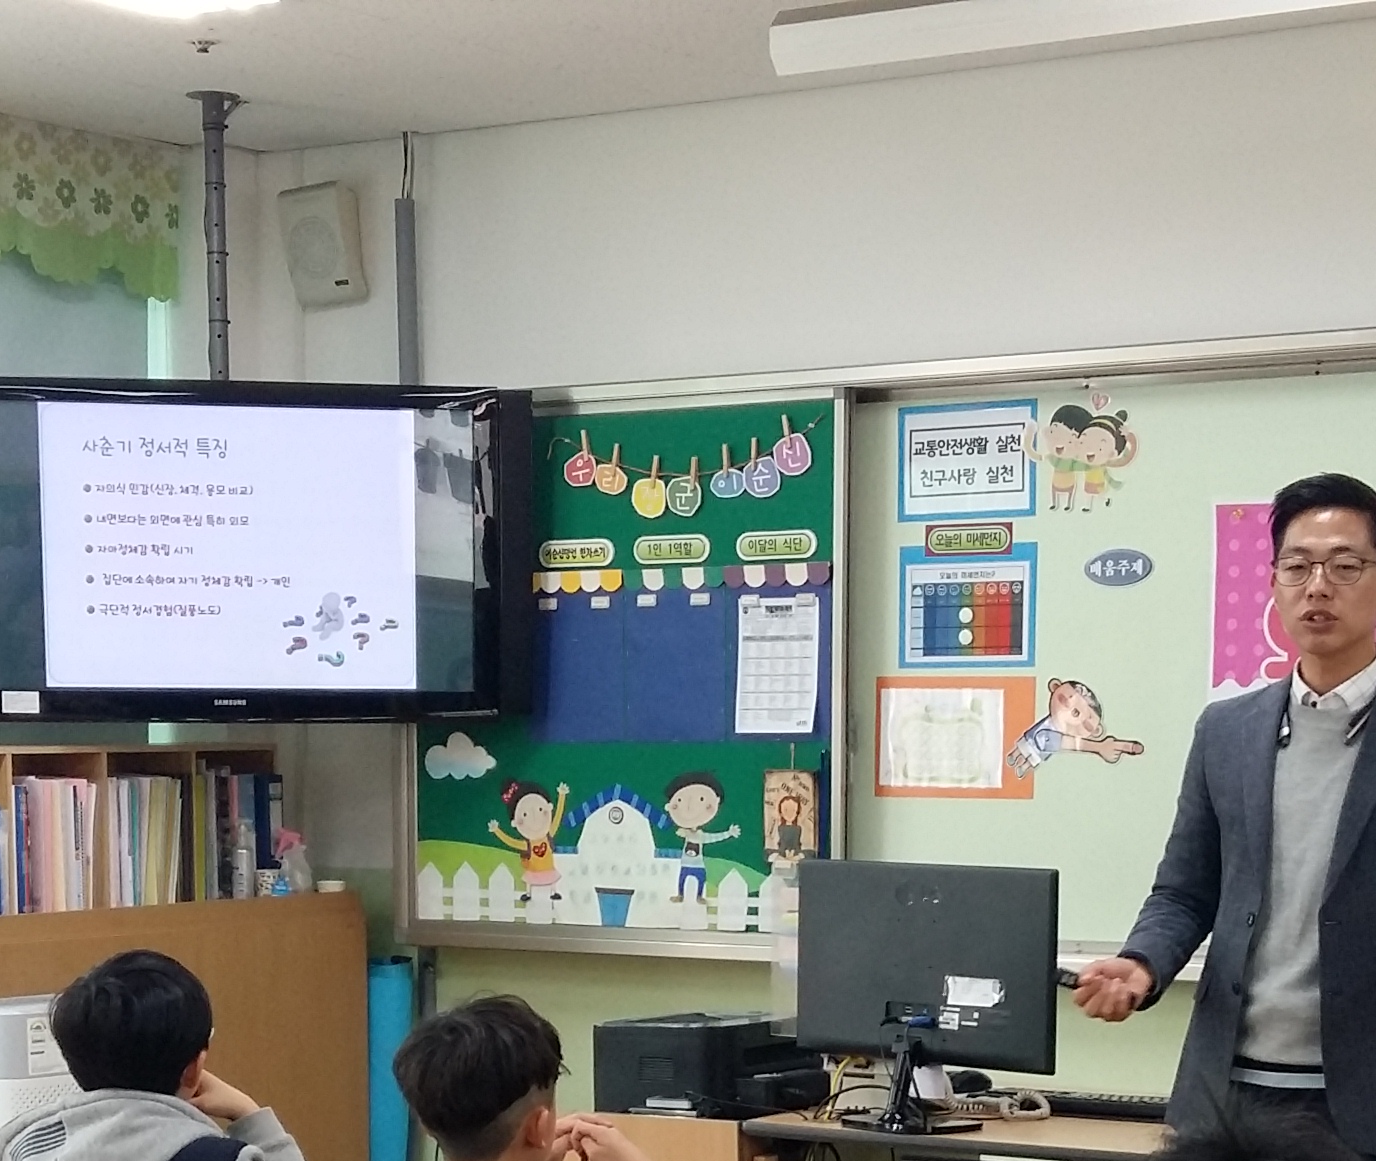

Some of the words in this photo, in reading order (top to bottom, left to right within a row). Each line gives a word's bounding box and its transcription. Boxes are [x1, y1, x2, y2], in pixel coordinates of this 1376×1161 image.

[82, 435, 132, 457] 사춘기
[138, 436, 188, 458] 정서적
[196, 437, 228, 459] 특징
[913, 436, 989, 458] 교통안전생활
[996, 433, 1022, 453] 실천
[920, 466, 977, 488] 친구사랑
[985, 464, 1014, 484] 실천
[96, 513, 147, 526] 내면보다는
[150, 514, 181, 526] 외면에
[182, 514, 203, 527] 관심
[747, 538, 777, 553] 이달의
[782, 537, 803, 552] 식단
[934, 532, 962, 548] 오늘의
[966, 531, 1002, 547] 미세먼지
[174, 545, 194, 556] 시기
[647, 543, 662, 557] 1인
[668, 541, 693, 556] 1역할
[1089, 558, 1143, 577] 배움주제
[102, 573, 133, 586] 집단에
